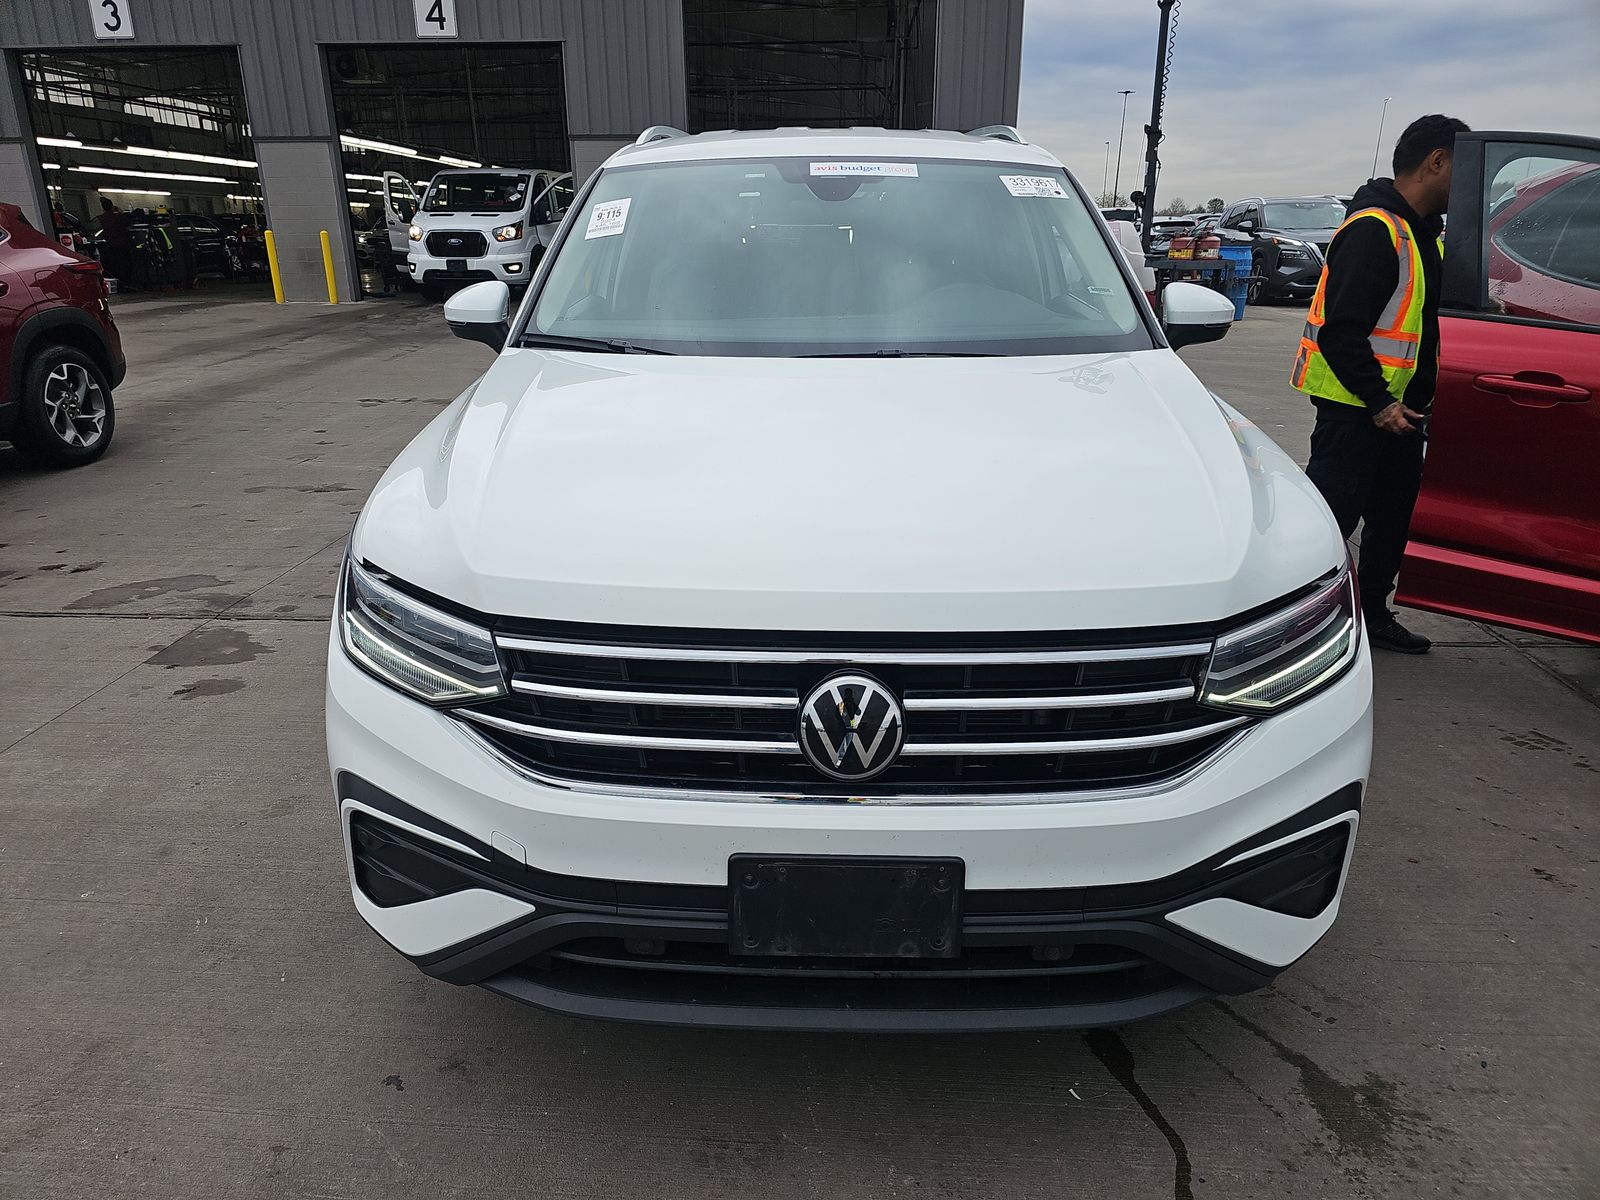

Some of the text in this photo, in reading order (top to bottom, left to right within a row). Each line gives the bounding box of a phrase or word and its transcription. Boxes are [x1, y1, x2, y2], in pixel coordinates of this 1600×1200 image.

[102, 0, 121, 31] 3
[425, 0, 446, 30] 4
[1009, 177, 1059, 188] 3319617
